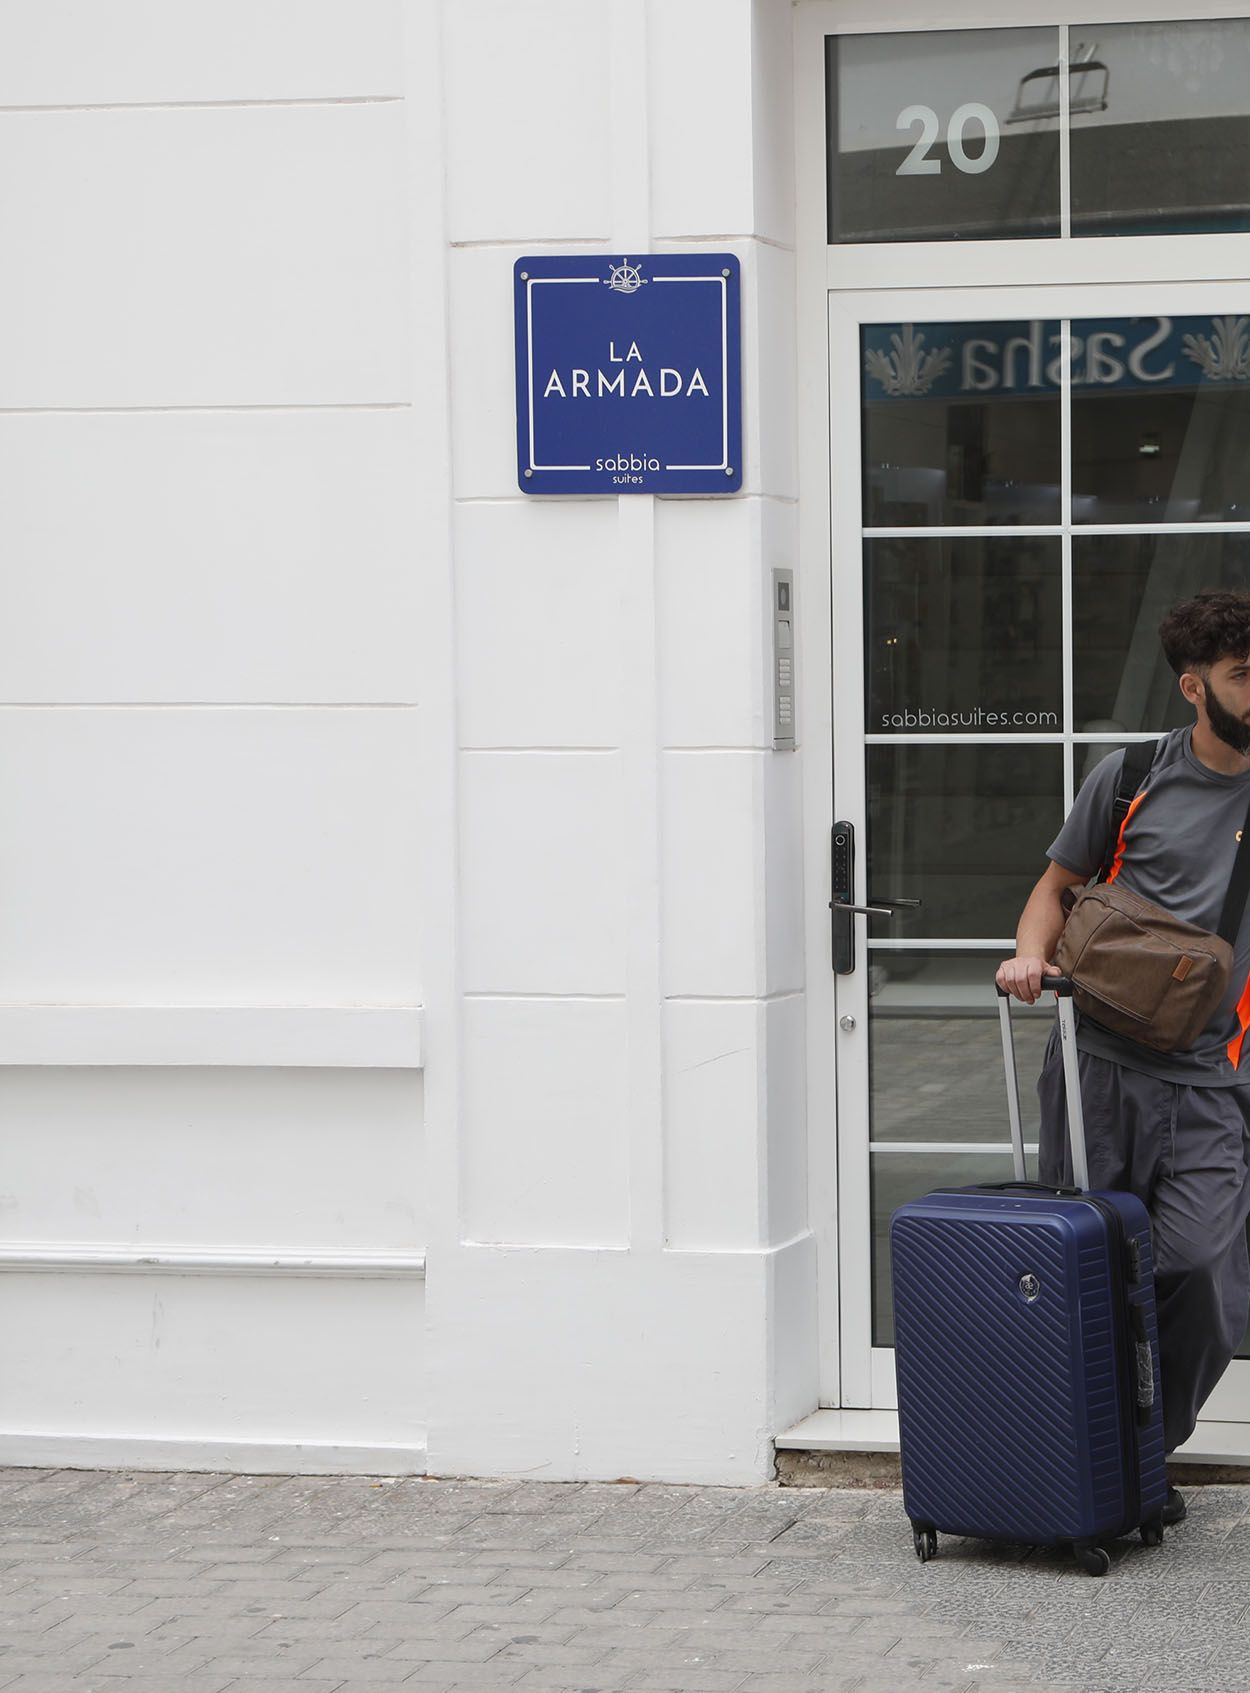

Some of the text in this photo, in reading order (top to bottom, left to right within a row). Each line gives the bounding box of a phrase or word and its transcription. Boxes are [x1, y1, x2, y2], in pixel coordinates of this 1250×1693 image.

[896, 102, 1000, 175] 20
[609, 341, 643, 362] LA
[543, 367, 710, 398] ARMADA
[595, 453, 660, 472] sabbia
[612, 473, 643, 484] suites
[882, 707, 1057, 727] sabbiasuites.com
